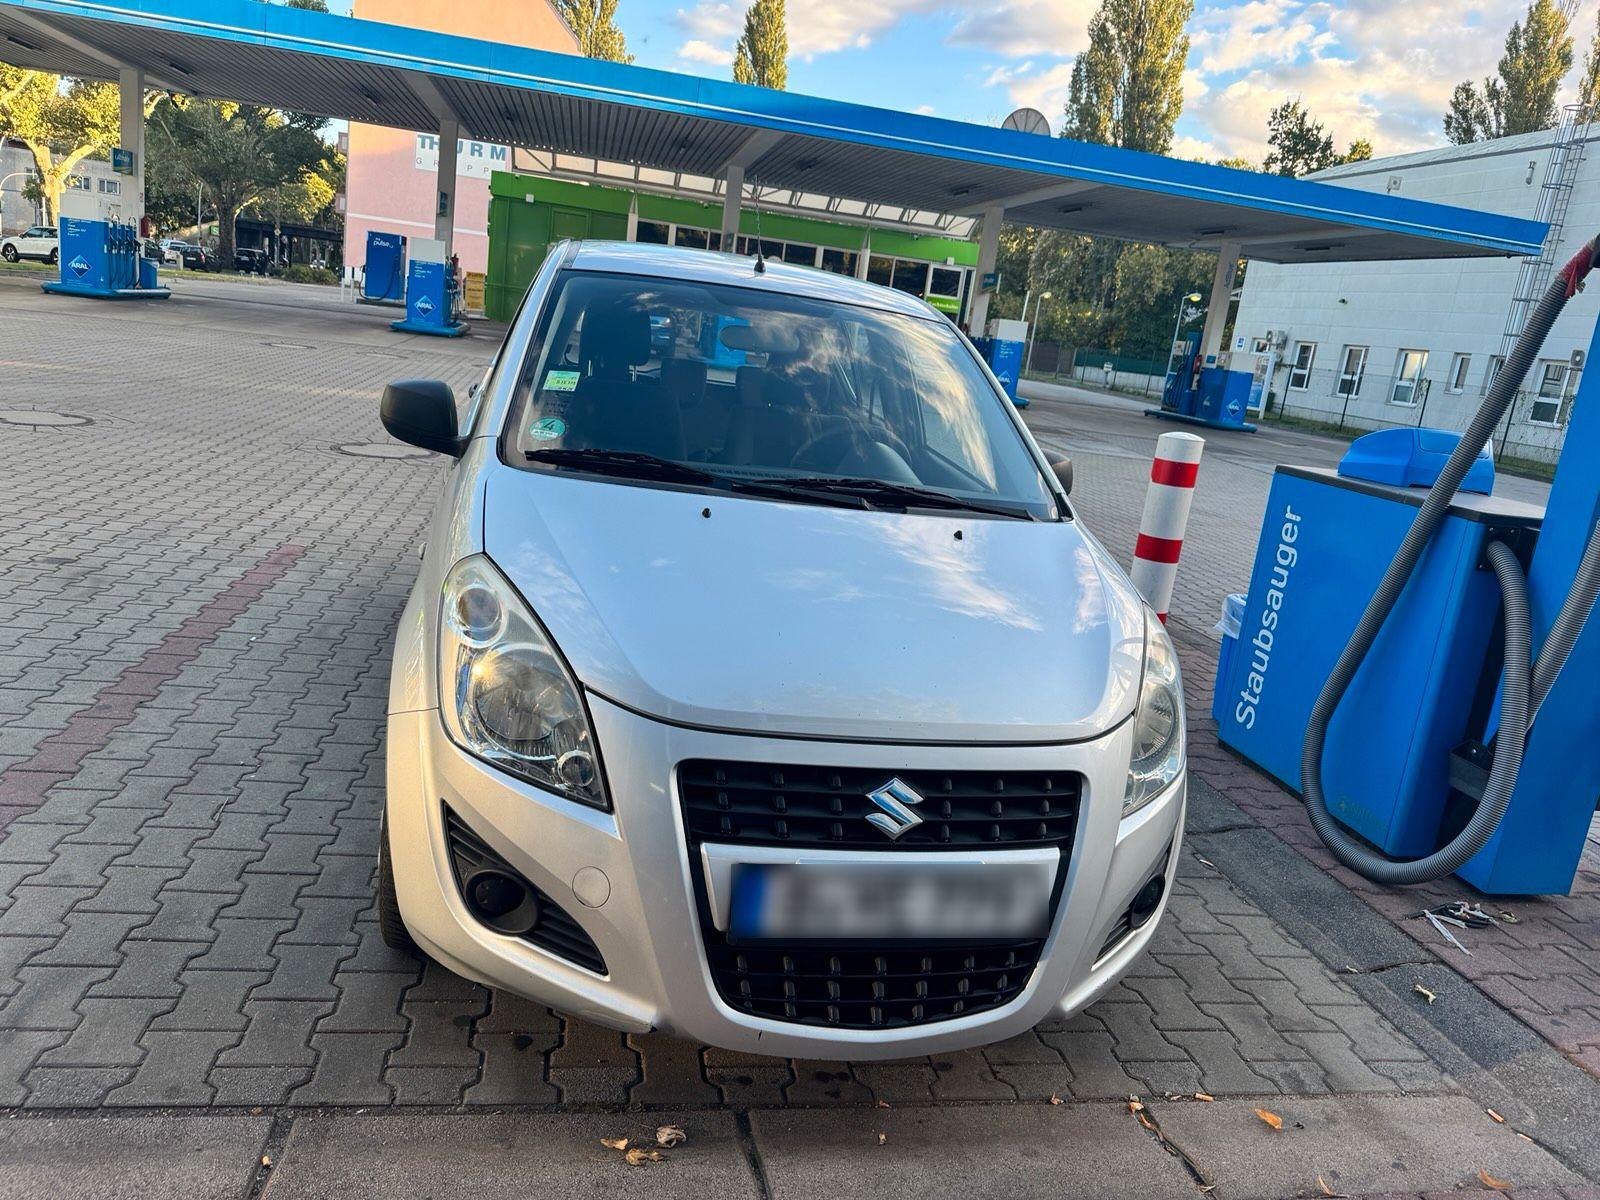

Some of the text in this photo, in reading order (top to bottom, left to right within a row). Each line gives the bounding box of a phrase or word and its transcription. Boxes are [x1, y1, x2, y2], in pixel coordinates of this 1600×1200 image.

[373, 240, 390, 248] pulse
[71, 261, 89, 270] ARAL
[544, 420, 556, 430] 4
[1235, 505, 1301, 729] Staubsauger
